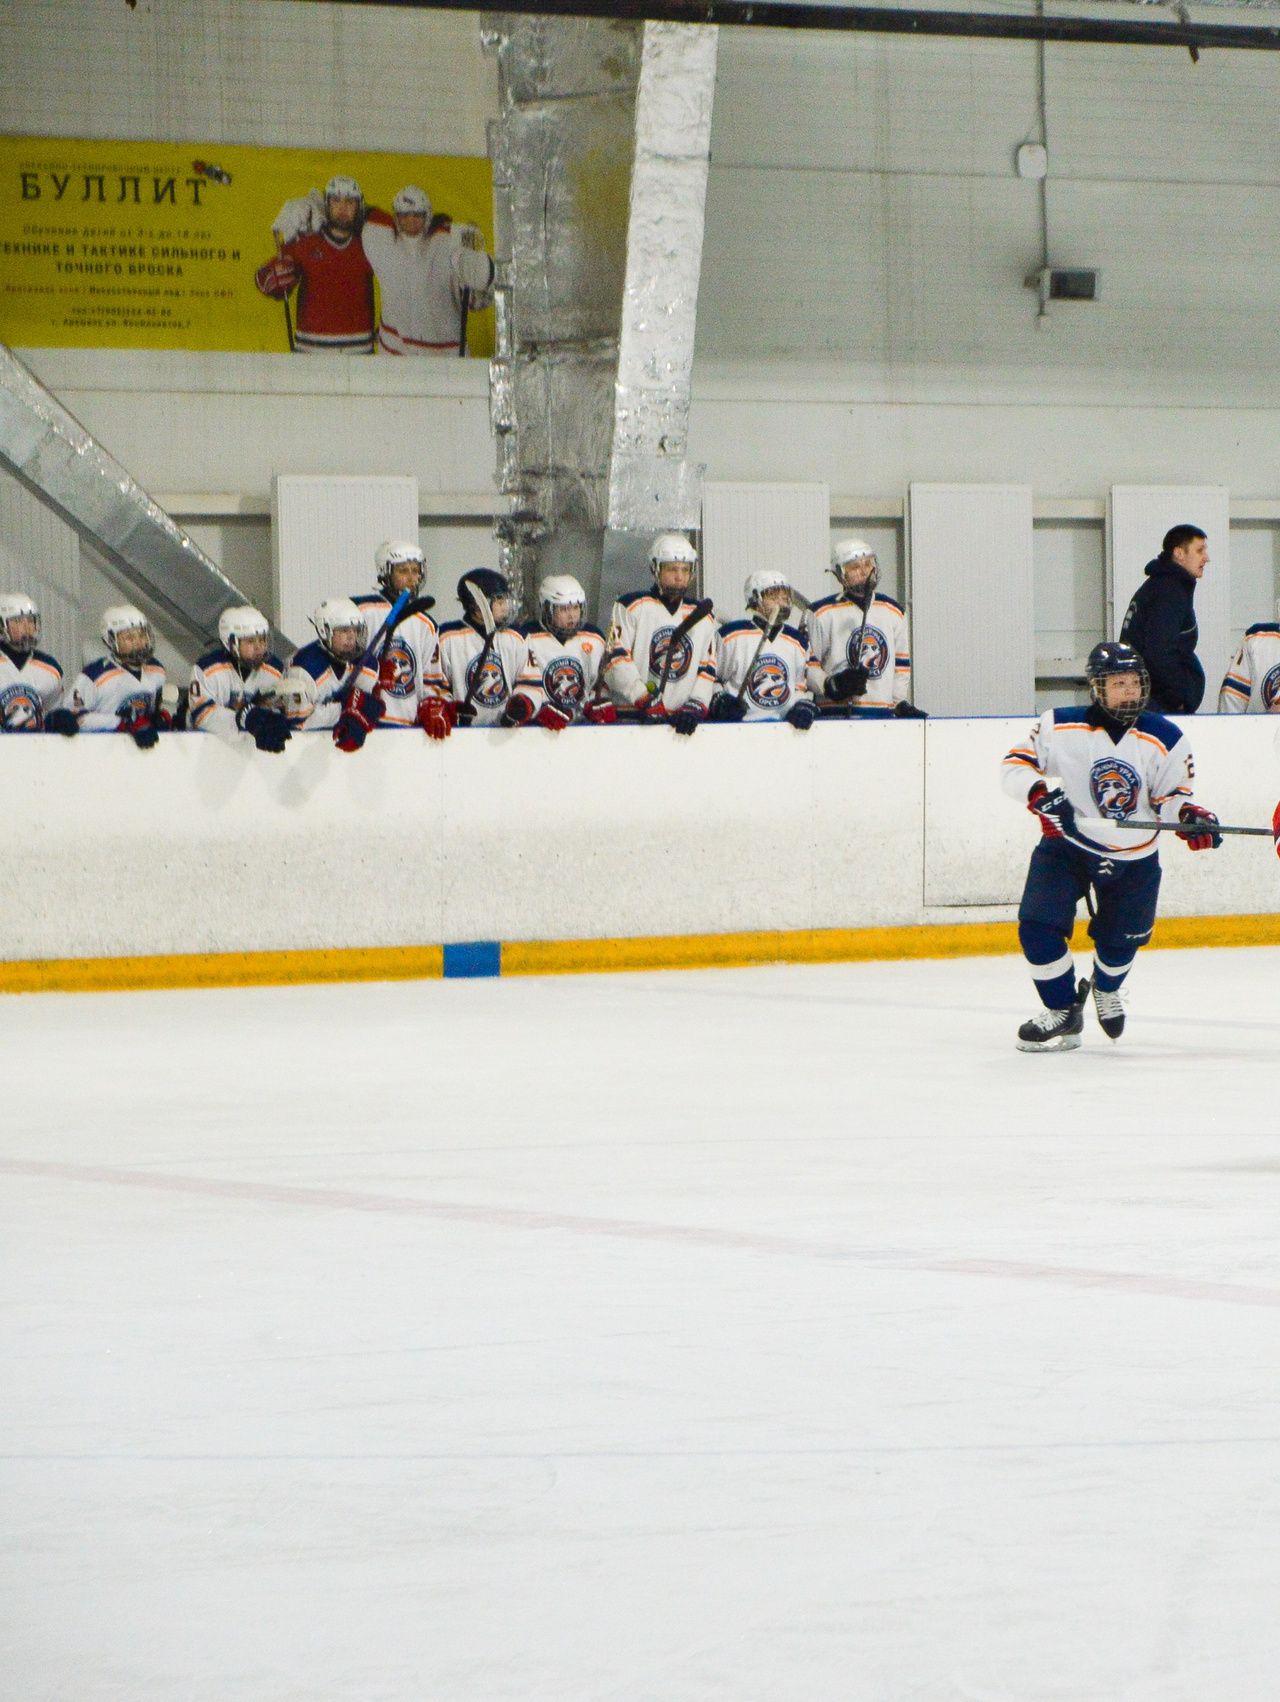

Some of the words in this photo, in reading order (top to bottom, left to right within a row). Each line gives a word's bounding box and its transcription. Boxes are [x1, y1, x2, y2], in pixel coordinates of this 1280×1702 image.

[20, 172, 207, 206] БУЛЛИТ
[1, 241, 59, 255] ЕХНИКЕ
[82, 243, 146, 259] ТАКТИКЕ
[152, 246, 226, 260] СИЛЬНОГО
[56, 261, 123, 275] ТОЧНОГО
[128, 262, 184, 277] БРОСКА
[1041, 795, 1066, 813] CC
